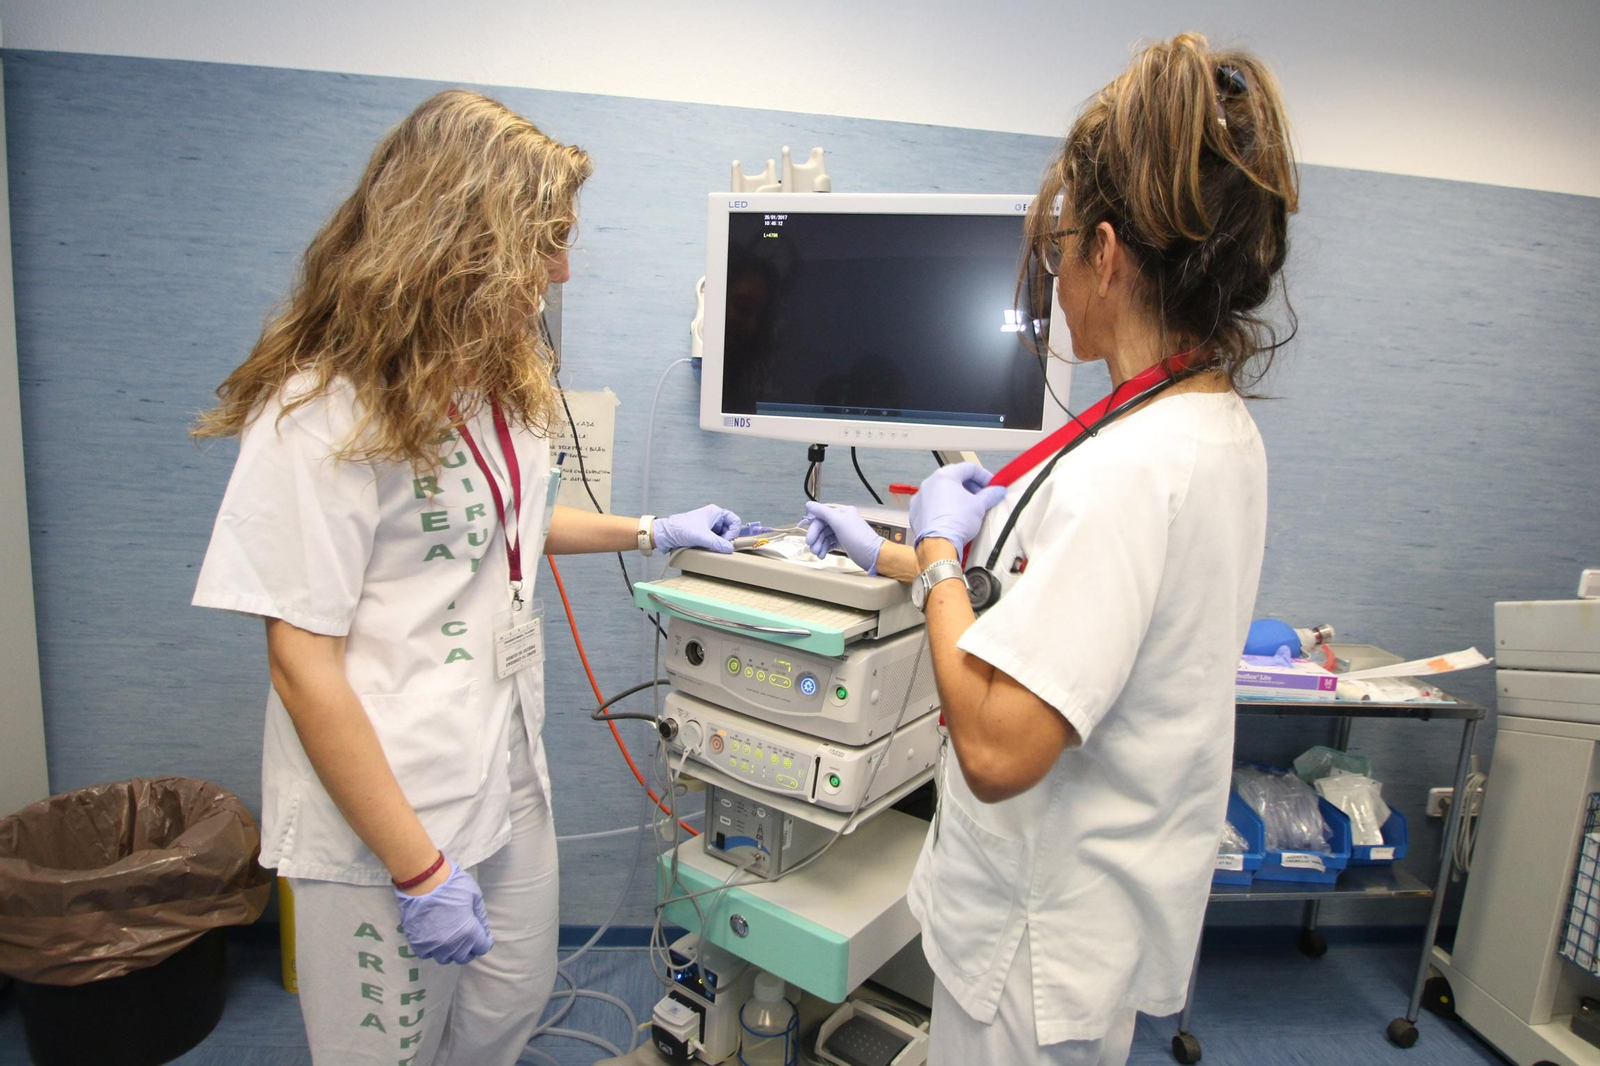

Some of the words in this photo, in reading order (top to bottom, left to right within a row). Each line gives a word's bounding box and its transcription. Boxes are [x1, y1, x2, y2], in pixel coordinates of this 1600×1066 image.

[734, 417, 750, 427] NDS
[405, 452, 455, 562] REA
[354, 921, 387, 1034] AREA
